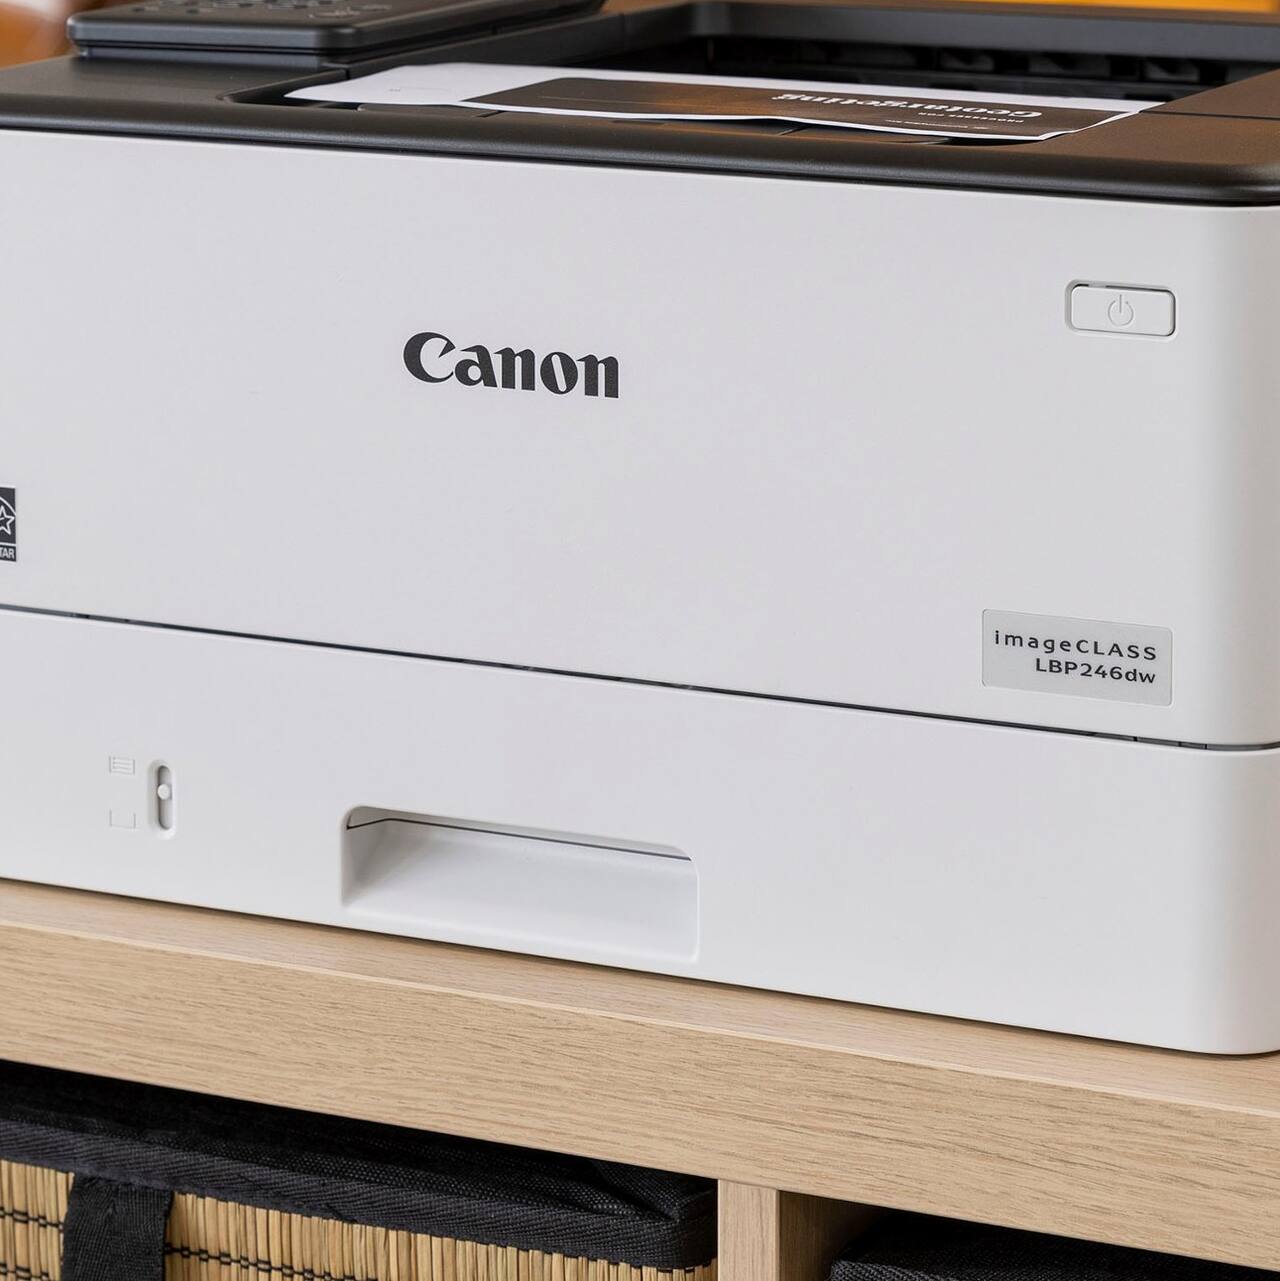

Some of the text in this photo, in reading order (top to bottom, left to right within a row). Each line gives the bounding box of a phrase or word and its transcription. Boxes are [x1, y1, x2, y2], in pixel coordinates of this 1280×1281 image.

[403, 331, 619, 399] Canon
[994, 629, 1157, 662] imageCLASS
[1035, 657, 1156, 684] LBP246dw
